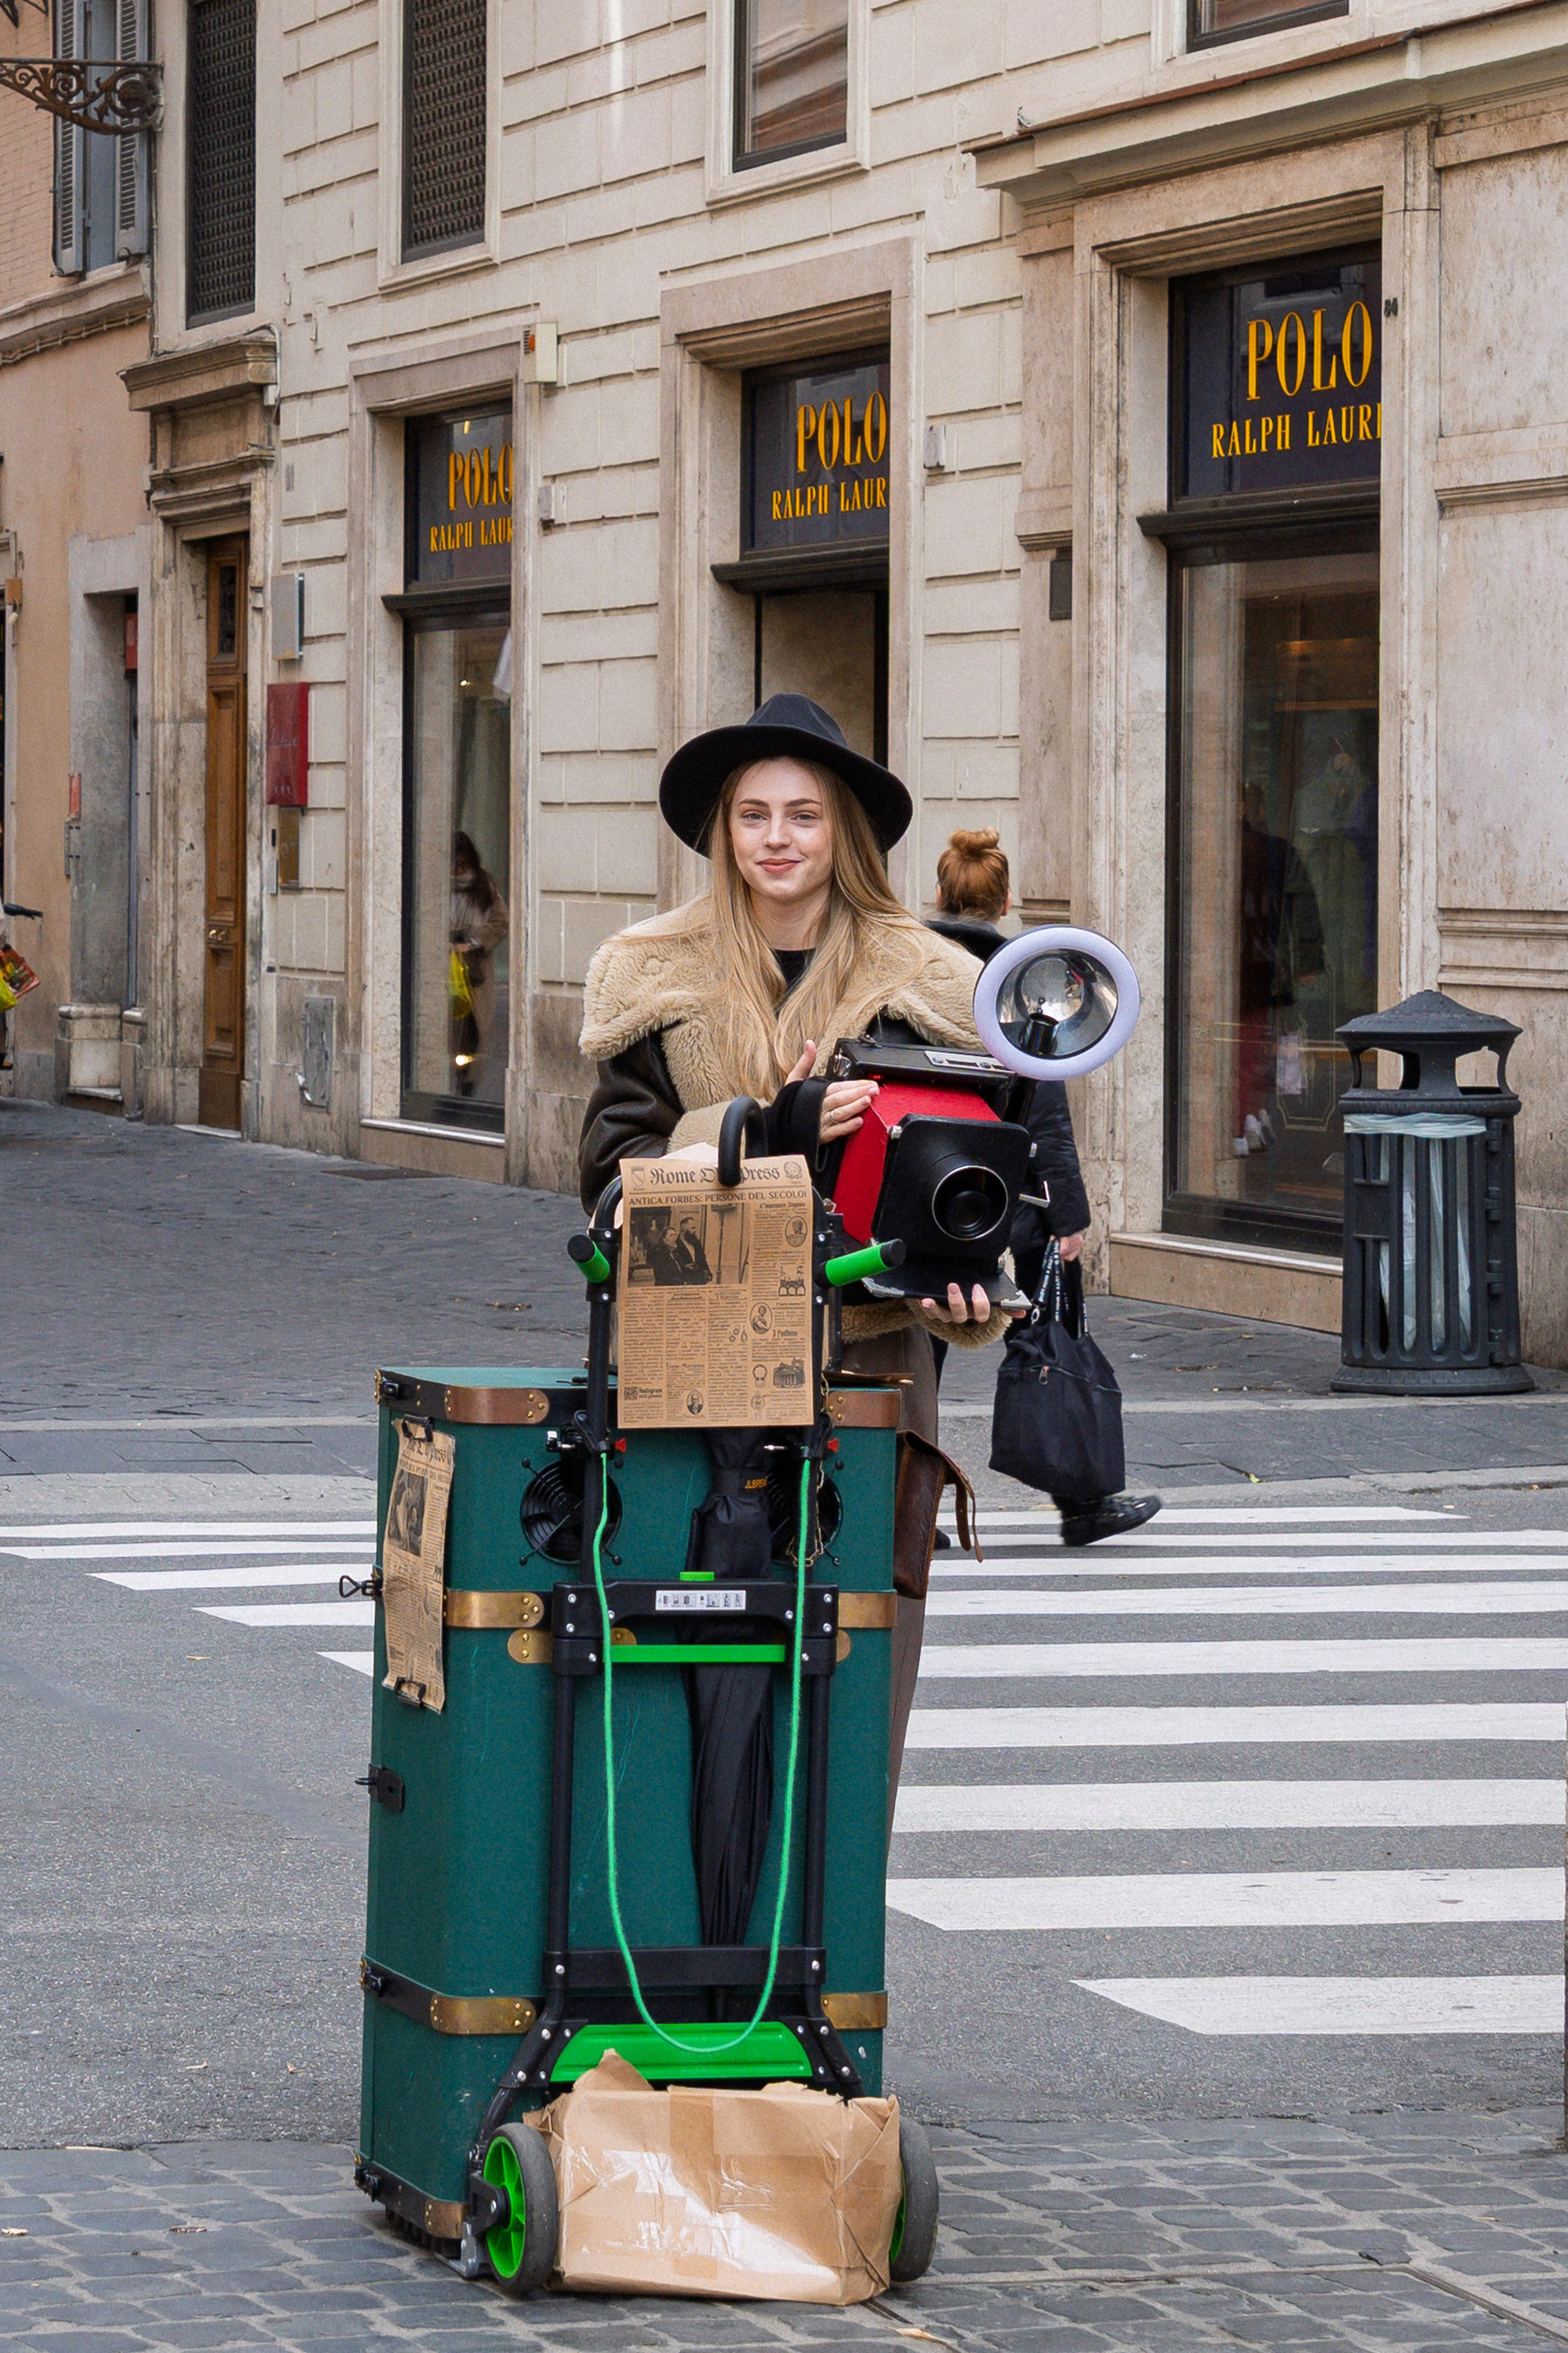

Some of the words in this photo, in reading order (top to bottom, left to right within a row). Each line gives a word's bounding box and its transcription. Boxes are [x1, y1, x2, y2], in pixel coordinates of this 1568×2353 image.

[1246, 301, 1373, 401] POLO
[797, 390, 887, 472] POLO
[1212, 414, 1291, 459] RALPH
[449, 442, 513, 510] POLO
[772, 485, 828, 519] RALPH
[840, 477, 887, 512] LAUR
[430, 522, 472, 552] RALPH
[650, 1168, 696, 1185] Rome
[629, 1196, 663, 1206] ANTICA
[665, 1195, 703, 1204] FORBES:
[705, 1193, 747, 1202] PERSONE
[748, 1192, 766, 1201] DEL
